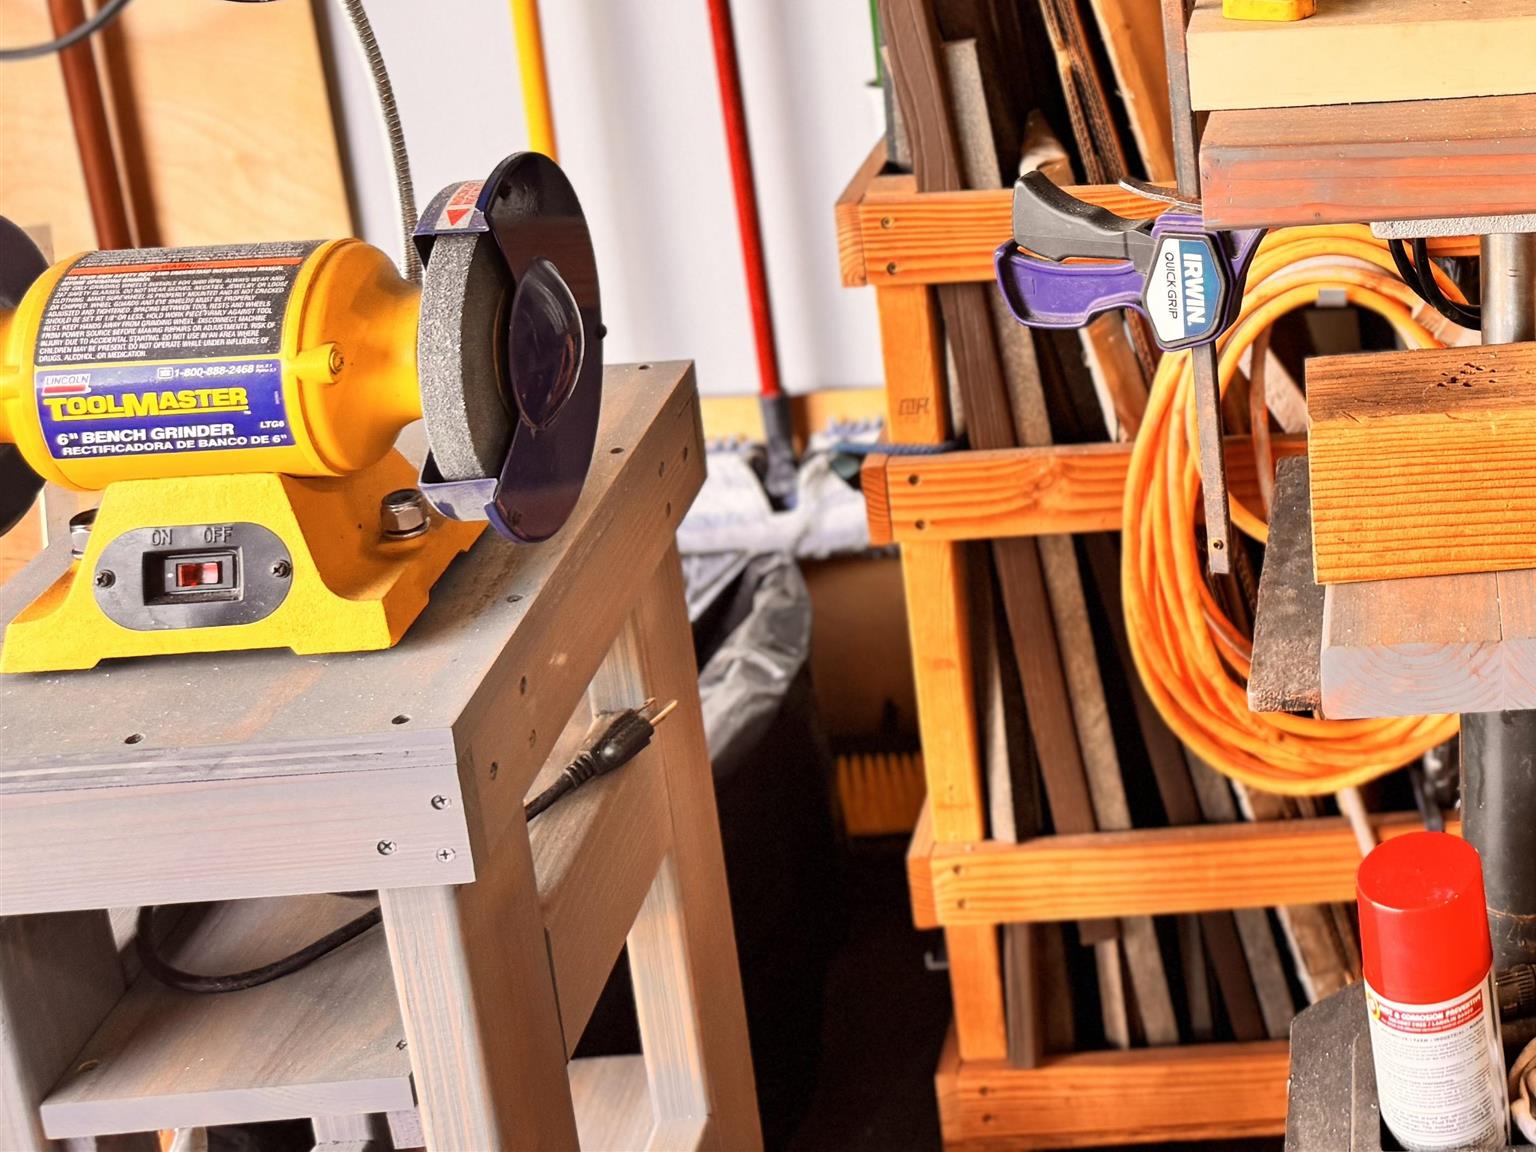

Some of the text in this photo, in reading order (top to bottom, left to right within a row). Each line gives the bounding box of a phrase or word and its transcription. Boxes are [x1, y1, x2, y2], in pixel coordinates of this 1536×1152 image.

[1183, 253, 1206, 324] IRWIN
[45, 375, 89, 386] LINCOLN
[43, 387, 249, 422] TOOLMASTER
[81, 429, 147, 444] BENCH
[150, 423, 235, 440] GRINDER
[62, 440, 174, 456] RECTIFICADORA
[176, 439, 195, 449] DE
[198, 436, 248, 448] BANCO
[250, 435, 270, 444] DE
[152, 527, 234, 546] ON OFF
